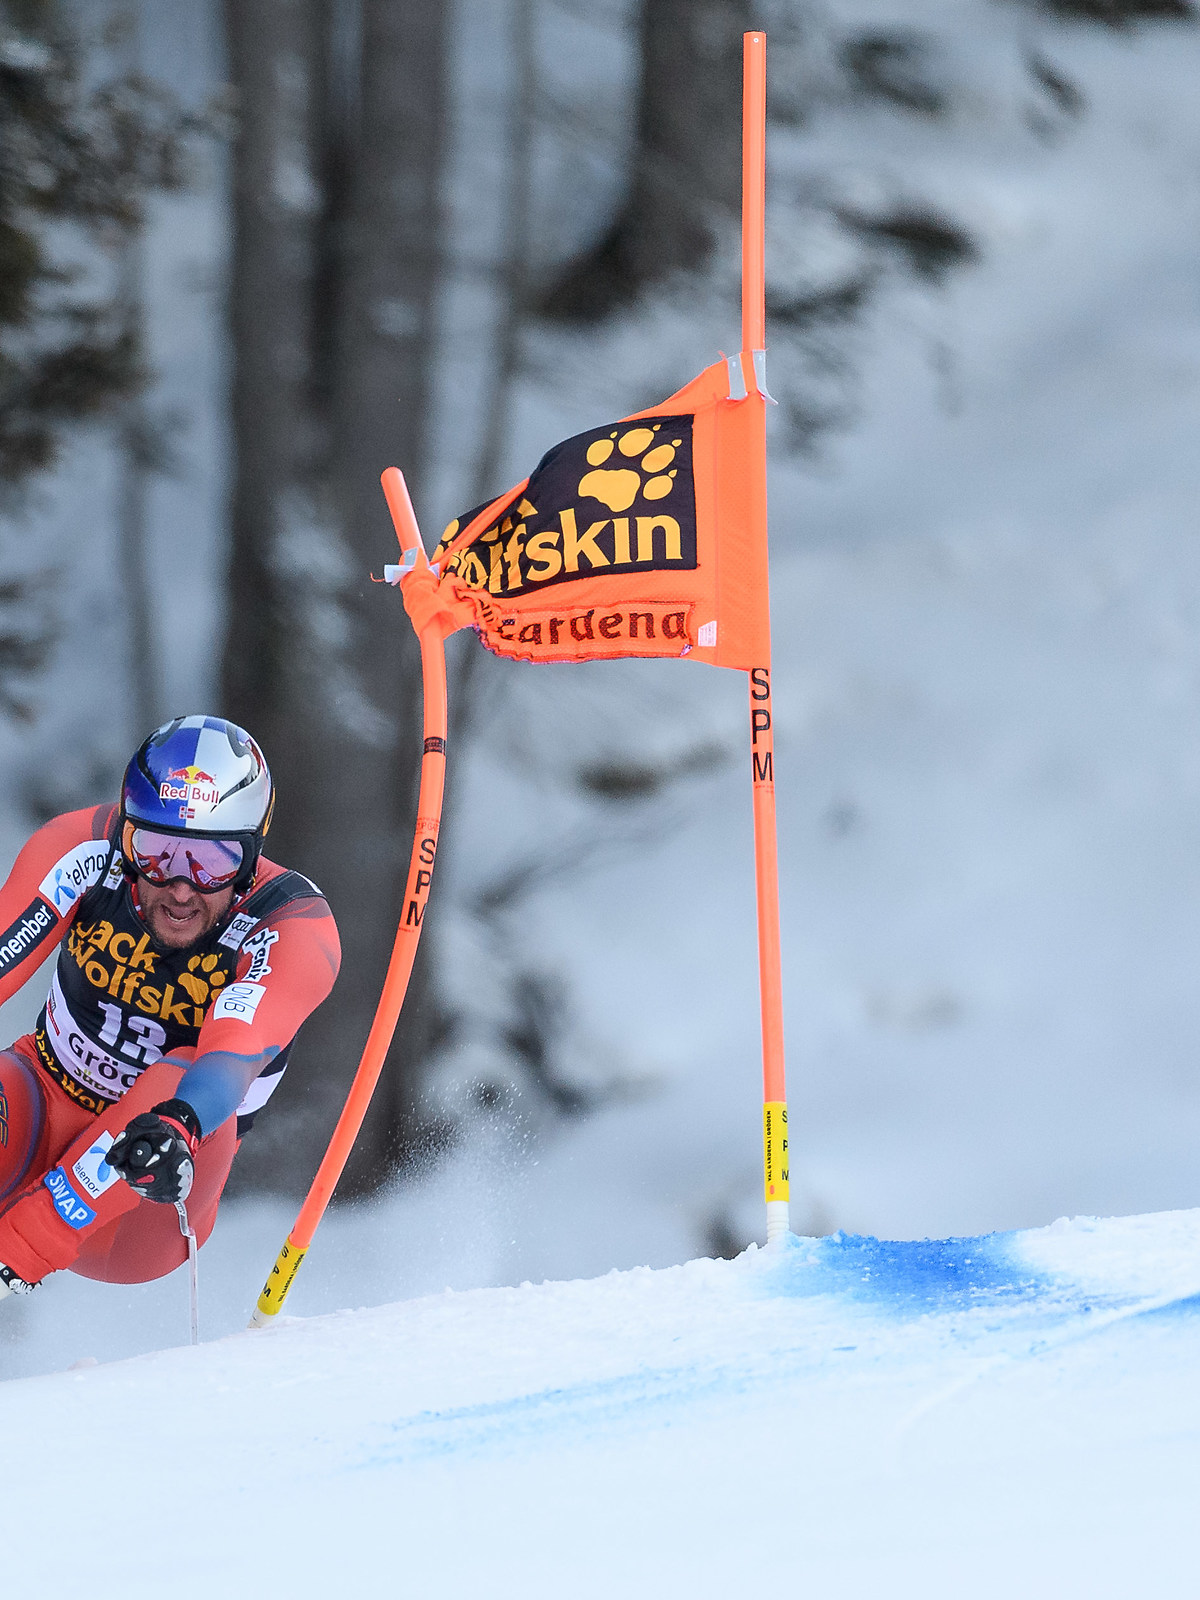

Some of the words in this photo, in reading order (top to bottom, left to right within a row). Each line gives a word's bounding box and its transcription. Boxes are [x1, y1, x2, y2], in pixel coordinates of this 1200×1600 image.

[161, 784, 188, 799] Red
[192, 787, 219, 804] Bull
[68, 929, 204, 1028] Wolfski
[98, 1000, 167, 1066] 13
[68, 1032, 143, 1088] Gröd
[49, 1174, 88, 1221] SWAP
[74, 1162, 100, 1193] telenor
